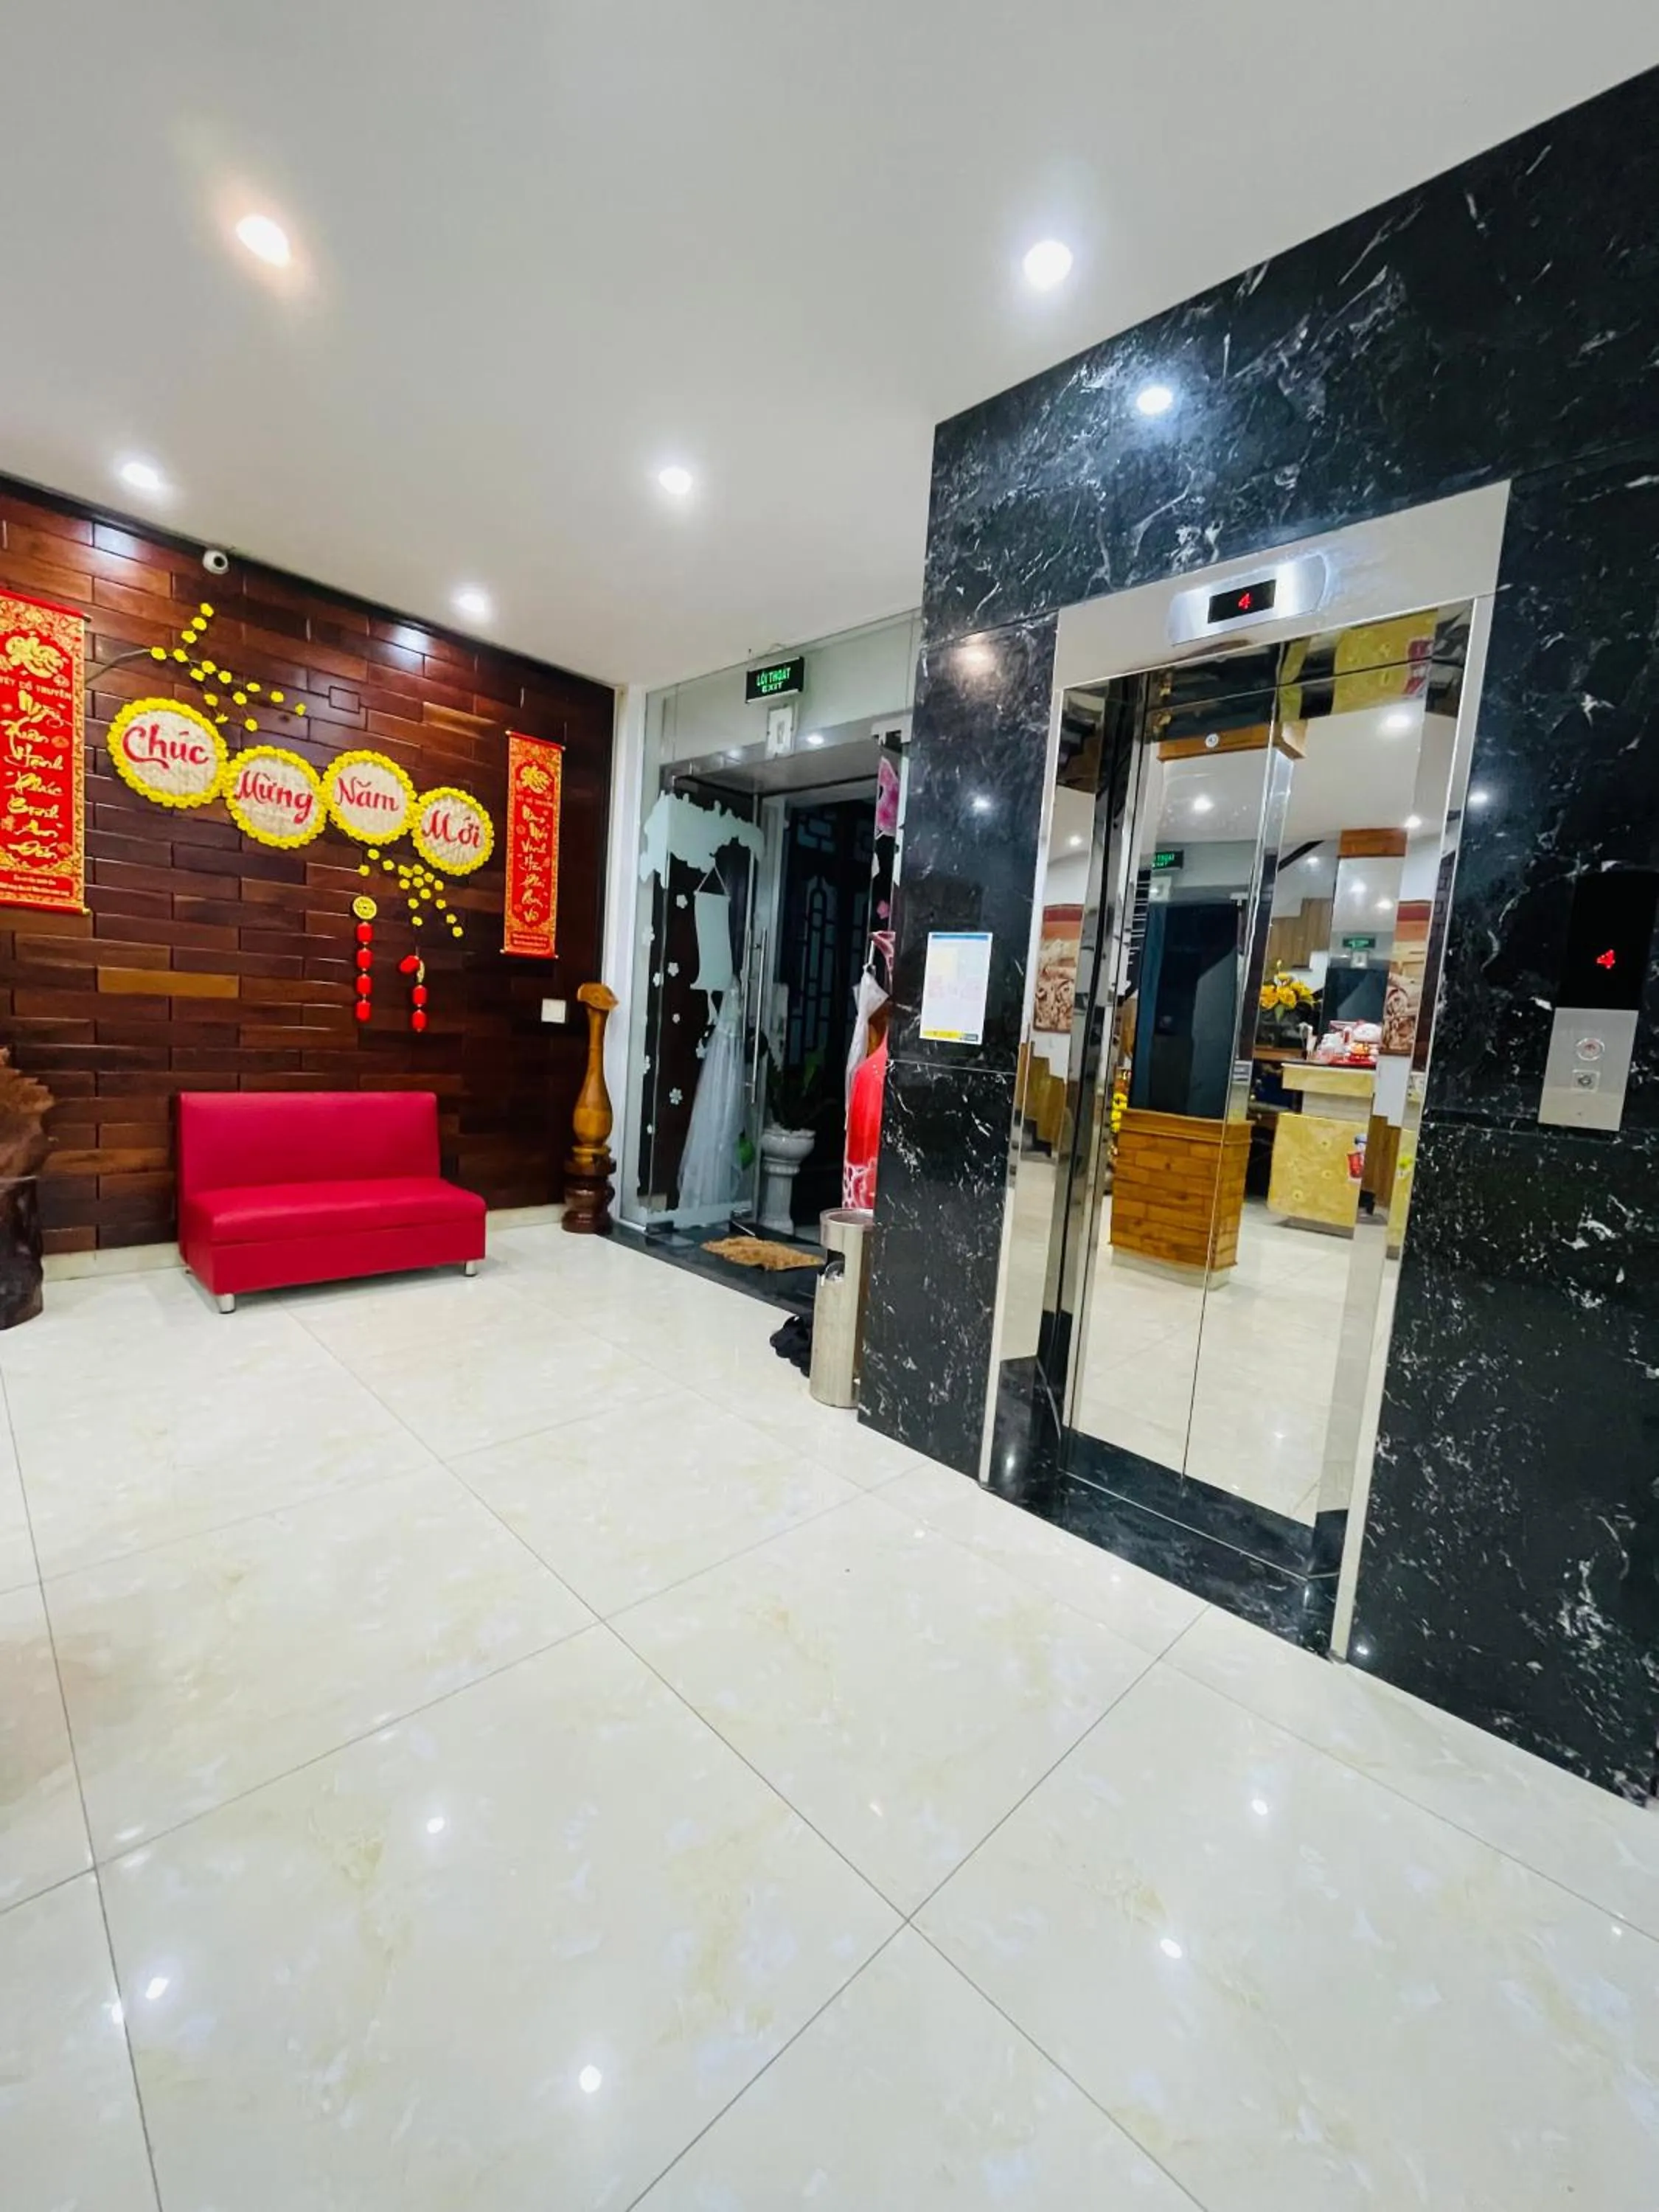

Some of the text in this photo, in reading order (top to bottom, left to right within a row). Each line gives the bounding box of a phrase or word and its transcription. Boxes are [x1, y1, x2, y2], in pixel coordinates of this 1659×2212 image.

[1238, 592, 1251, 610] 4
[762, 681, 783, 693] EXIT
[122, 724, 479, 848] Chúc Mừng Năm Mới
[1596, 949, 1615, 970] 4
